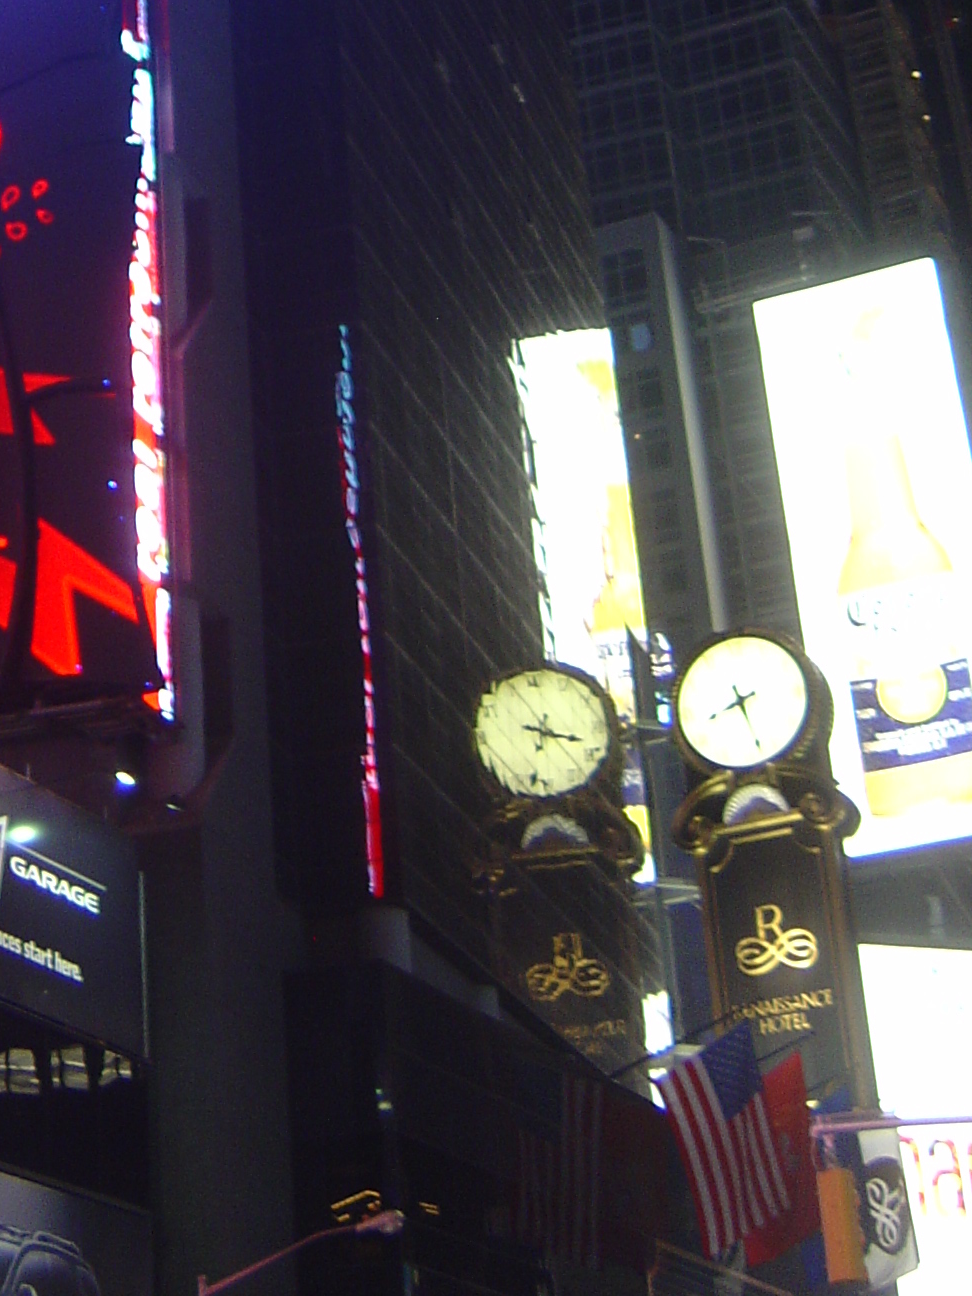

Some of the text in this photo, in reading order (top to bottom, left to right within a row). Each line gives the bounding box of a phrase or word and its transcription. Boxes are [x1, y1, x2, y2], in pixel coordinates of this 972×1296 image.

[9, 855, 100, 916] GARAGE
[24, 940, 53, 969] start
[54, 952, 84, 982] here.
[759, 1012, 812, 1036] HOTEL
